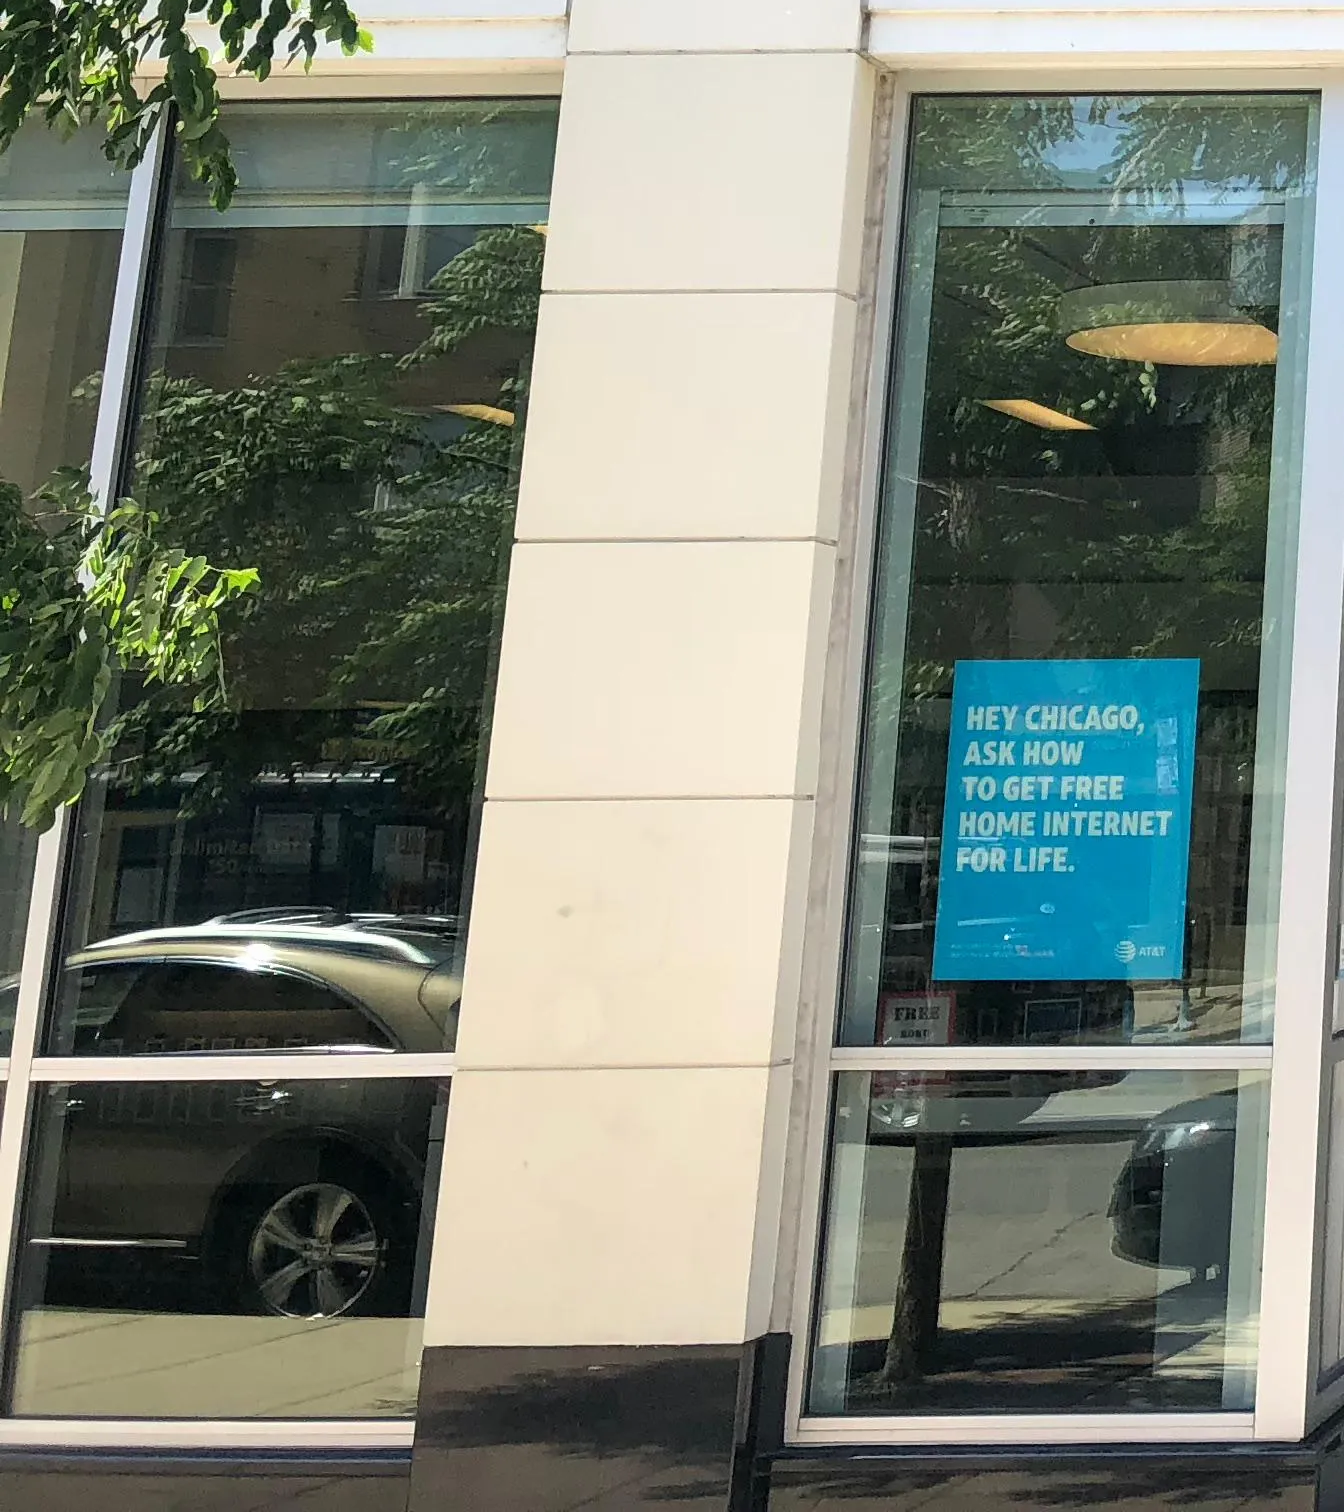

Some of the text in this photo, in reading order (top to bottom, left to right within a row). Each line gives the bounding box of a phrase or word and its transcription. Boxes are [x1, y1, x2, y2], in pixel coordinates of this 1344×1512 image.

[966, 704, 1145, 736] HEY CHICAGO,
[963, 740, 1084, 766] ASK HOW
[961, 775, 1125, 801] TO GET FREE
[958, 810, 1173, 837] HOME INTERNET
[955, 846, 1076, 873] FOR LIFE.
[894, 1006, 941, 1021] FREE
